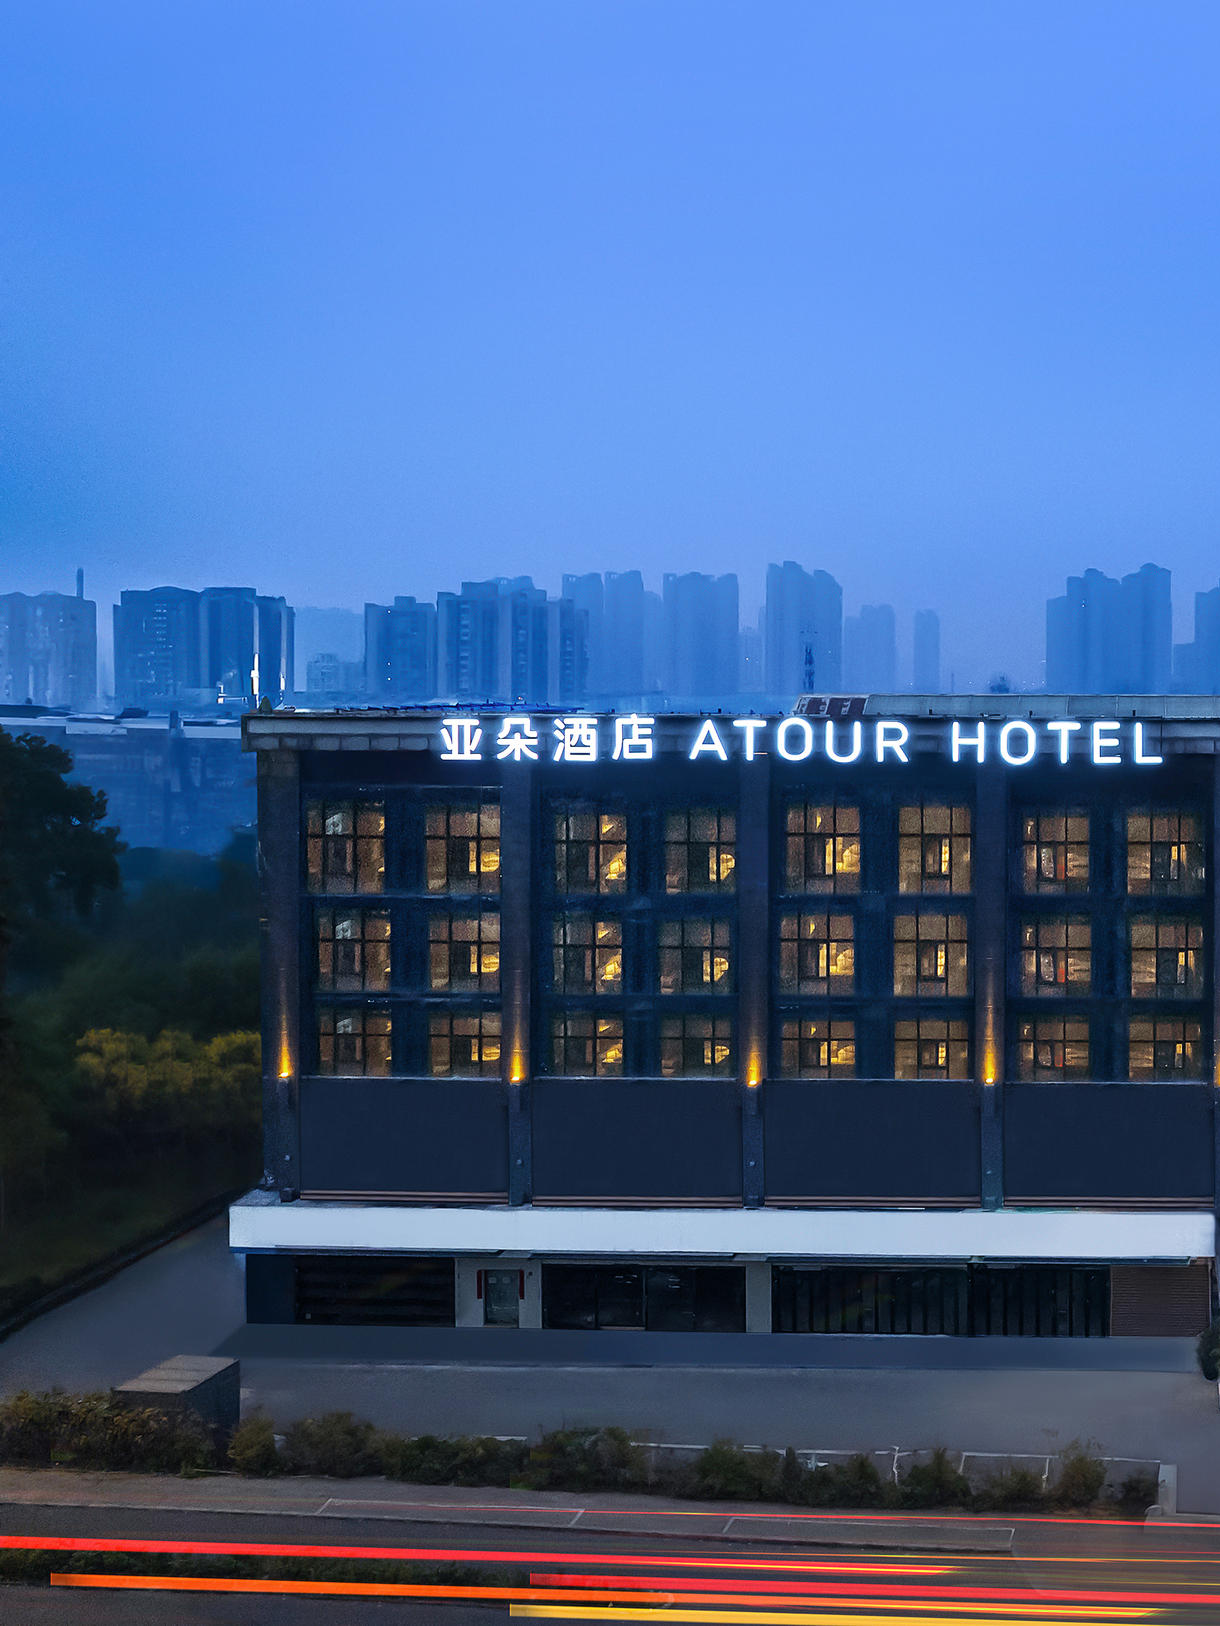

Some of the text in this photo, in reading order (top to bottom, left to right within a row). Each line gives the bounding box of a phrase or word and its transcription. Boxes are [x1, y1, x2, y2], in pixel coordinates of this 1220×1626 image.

[440, 713, 655, 761] 亚朵酒店
[689, 717, 1163, 764] ATOUR HOTEL
